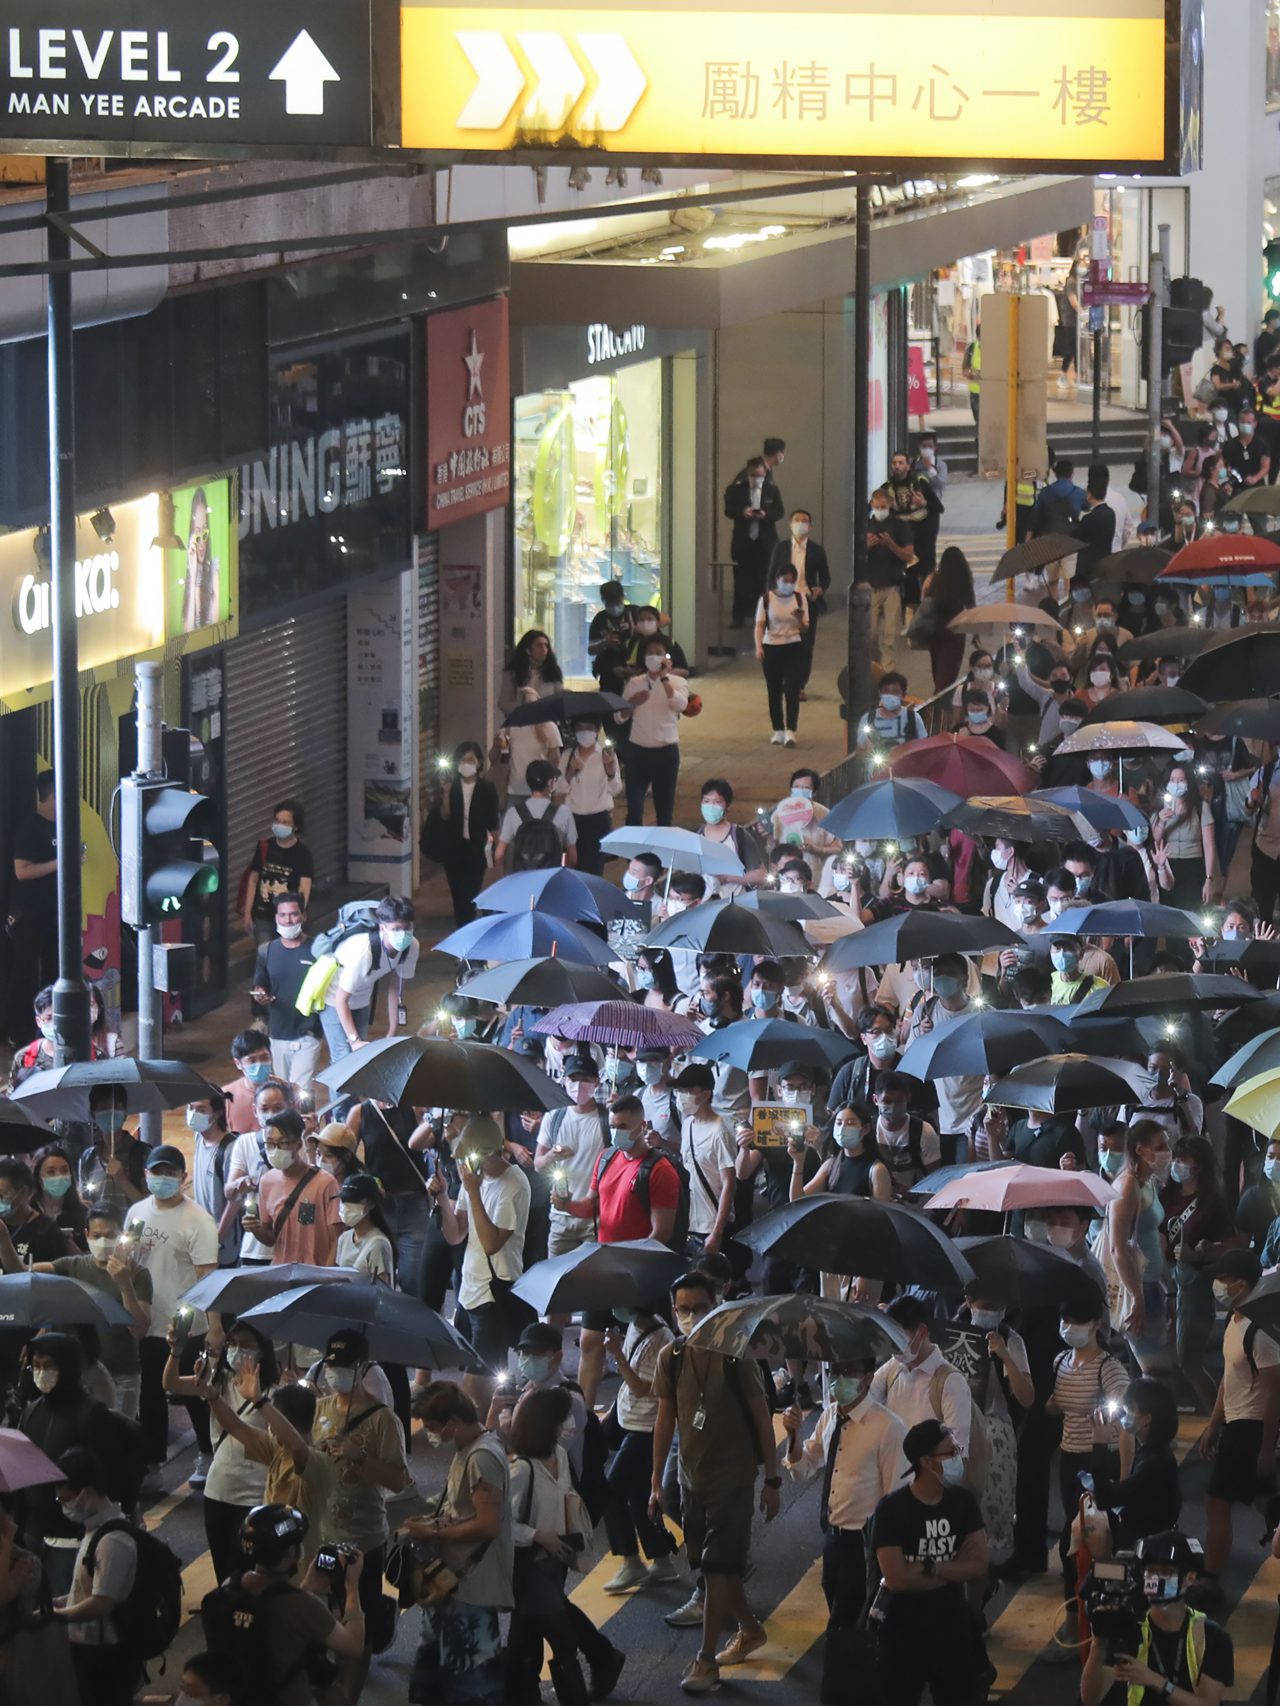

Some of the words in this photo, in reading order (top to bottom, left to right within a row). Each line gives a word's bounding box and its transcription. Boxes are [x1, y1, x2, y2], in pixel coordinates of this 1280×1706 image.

[9, 28, 182, 82] LEVEL
[206, 31, 240, 83] 2
[8, 93, 70, 115] MAN
[80, 94, 124, 117] YEE
[133, 95, 240, 119] ARCADE
[701, 60, 1112, 126] 勵精中心一樓
[464, 402, 487, 438] CTS
[925, 1518, 951, 1539] NO
[918, 1534, 957, 1557] EASY
